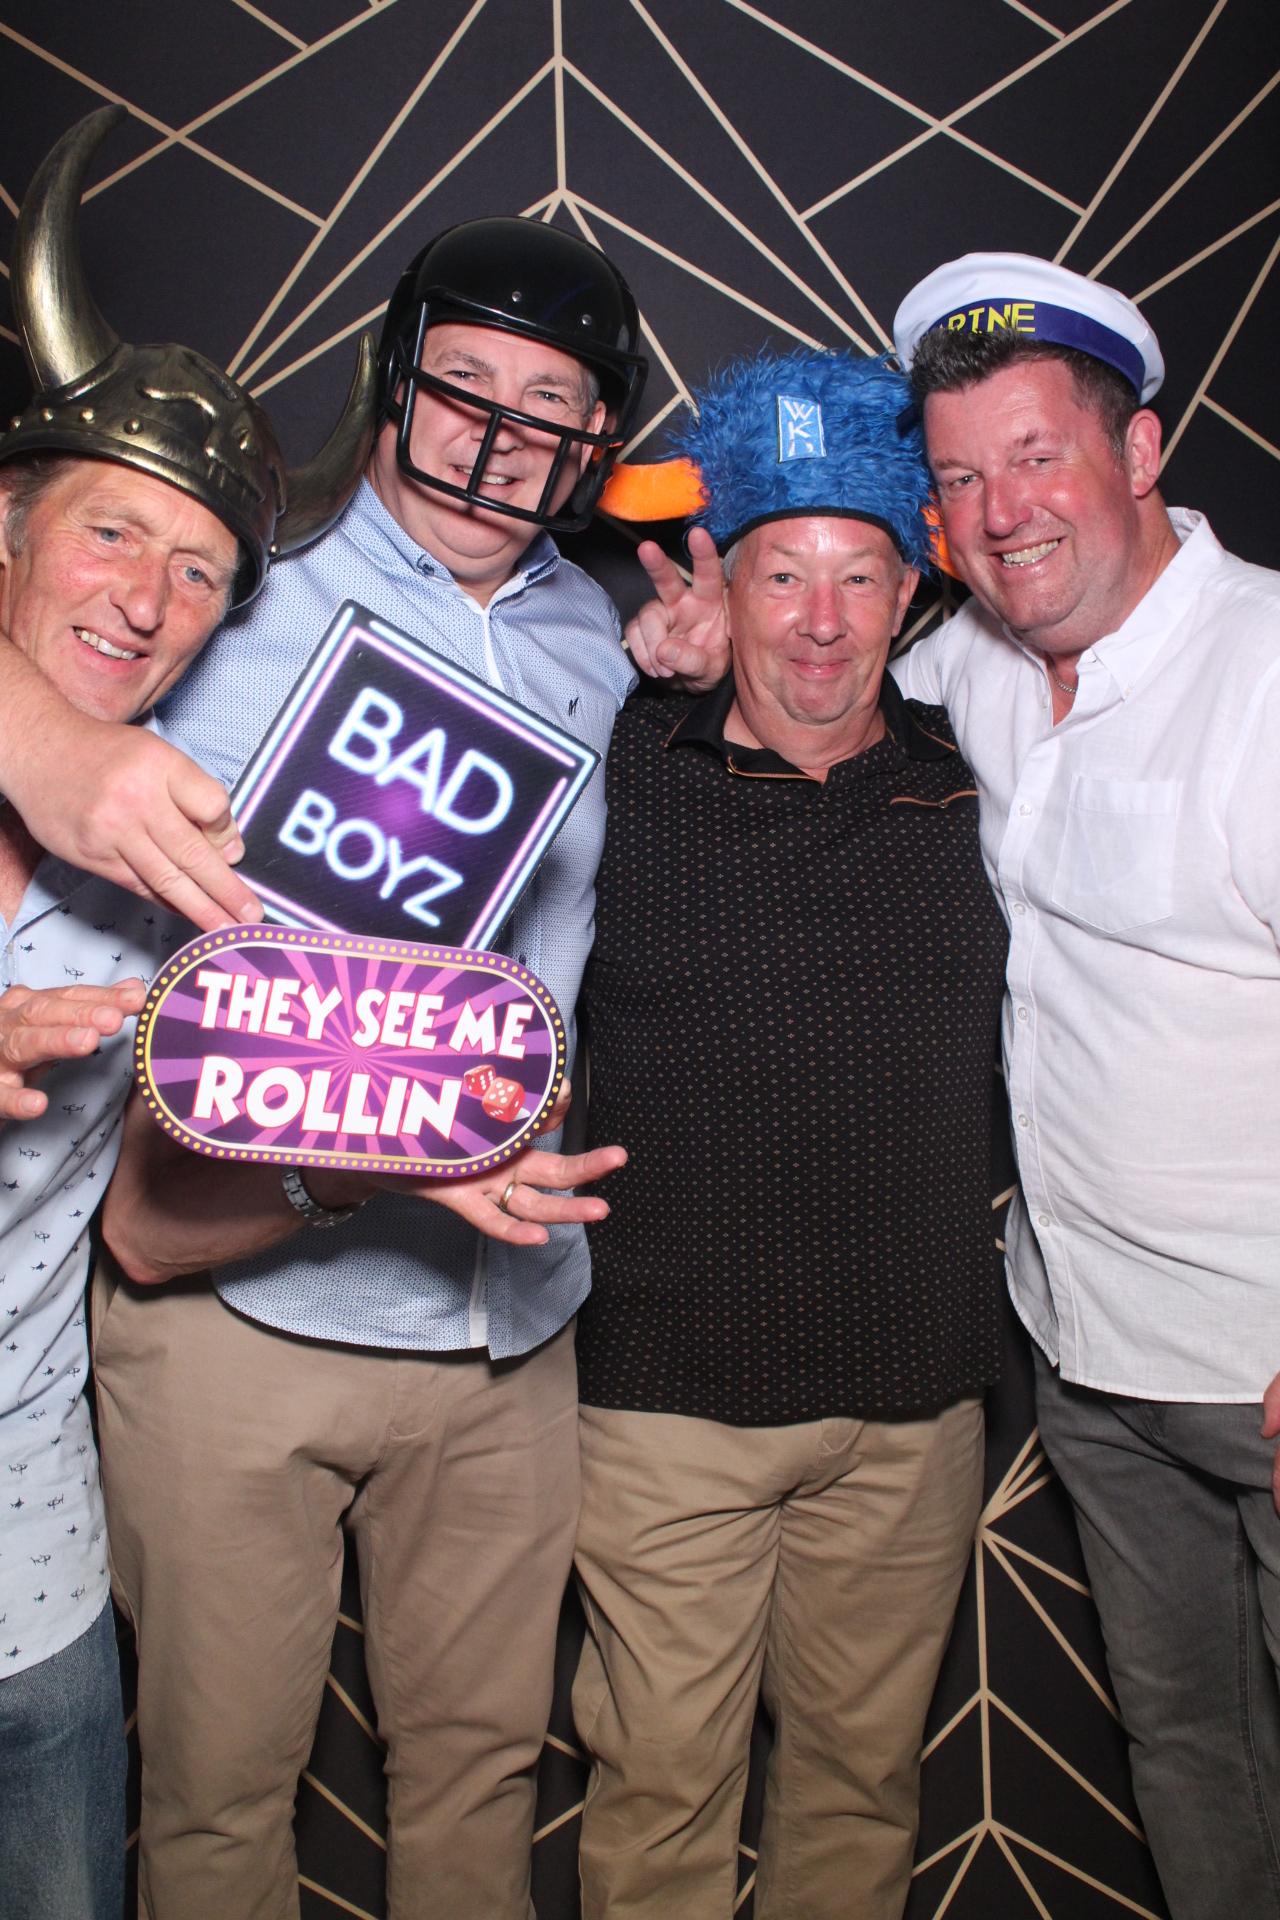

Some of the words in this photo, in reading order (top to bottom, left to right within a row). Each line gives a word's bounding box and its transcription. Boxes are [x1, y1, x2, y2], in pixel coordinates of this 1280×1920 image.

[328, 686, 514, 835] BAD
[278, 788, 464, 928] BOYZ
[195, 968, 344, 1041] THEY
[350, 988, 445, 1051] SEE
[448, 1000, 535, 1061] ME
[192, 1055, 464, 1141] ROLLIN
